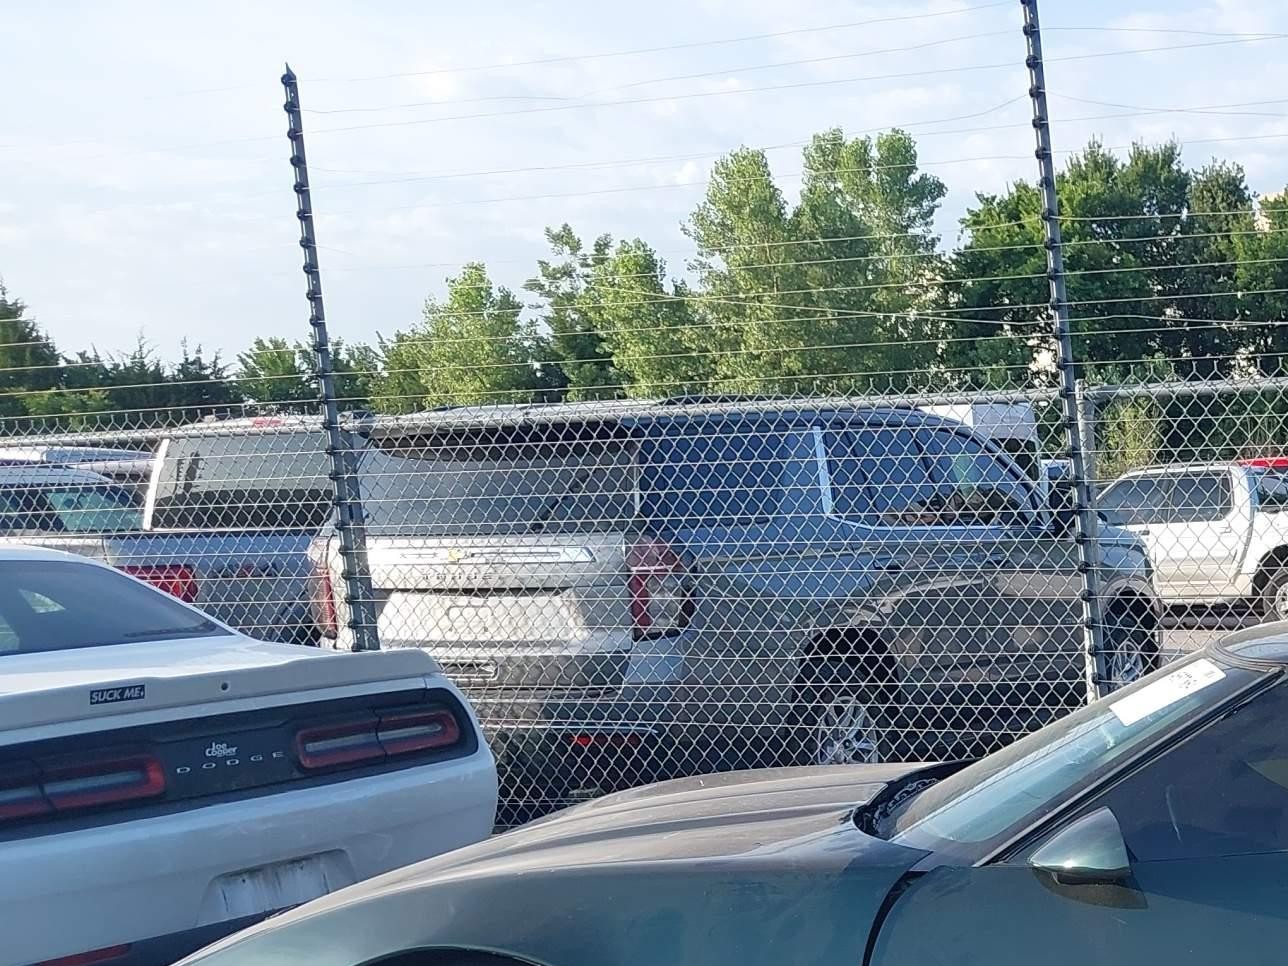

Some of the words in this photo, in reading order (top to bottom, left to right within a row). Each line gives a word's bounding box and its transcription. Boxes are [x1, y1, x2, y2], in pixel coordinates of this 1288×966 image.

[91, 688, 122, 703] SUCK
[205, 746, 238, 757] Cooper
[212, 741, 227, 751] Joe
[176, 751, 284, 774] DODGE
